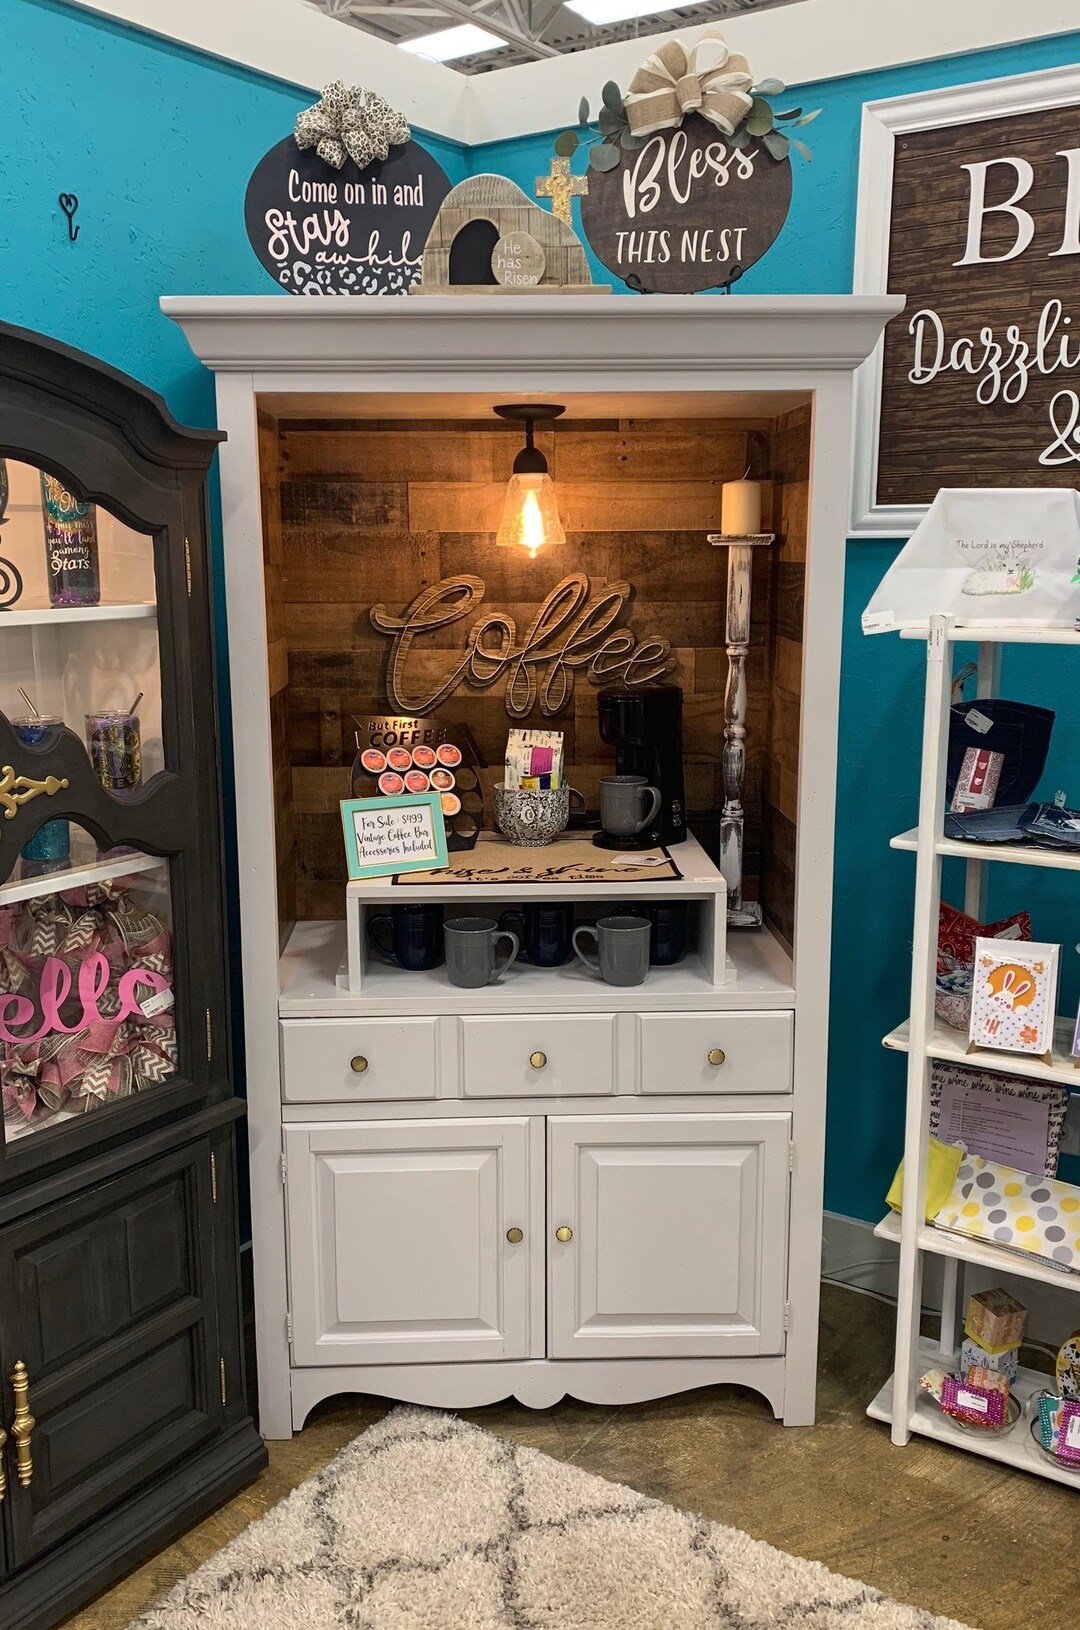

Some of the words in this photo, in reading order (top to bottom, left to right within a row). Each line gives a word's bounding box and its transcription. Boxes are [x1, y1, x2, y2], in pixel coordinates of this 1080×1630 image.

[623, 131, 760, 219] Bless
[288, 168, 337, 204] Come
[344, 183, 366, 205] on
[371, 176, 388, 205] in
[394, 174, 424, 207] and
[264, 208, 351, 261] Stay
[504, 239, 522, 255] He
[616, 230, 671, 264] THIS
[681, 227, 748, 263] NEST
[497, 254, 522, 269] has
[504, 270, 539, 285] Risen
[59, 545, 90, 560] among
[956, 539, 969, 549] The
[971, 539, 989, 549] Lord
[991, 540, 997, 549] is
[999, 542, 1010, 553] my
[1012, 539, 1044, 553] Shepherd
[369, 572, 678, 720] Coffee
[368, 720, 390, 732] But
[392, 719, 419, 731] First
[369, 728, 447, 748] COFFEE
[362, 817, 375, 830] For
[402, 813, 423, 825] $499
[357, 832, 385, 845] Vintage
[387, 828, 412, 842] Coffee
[414, 826, 429, 839] Bar
[359, 845, 400, 858] Accessories
[402, 839, 433, 854] Included
[513, 866, 534, 874] &
